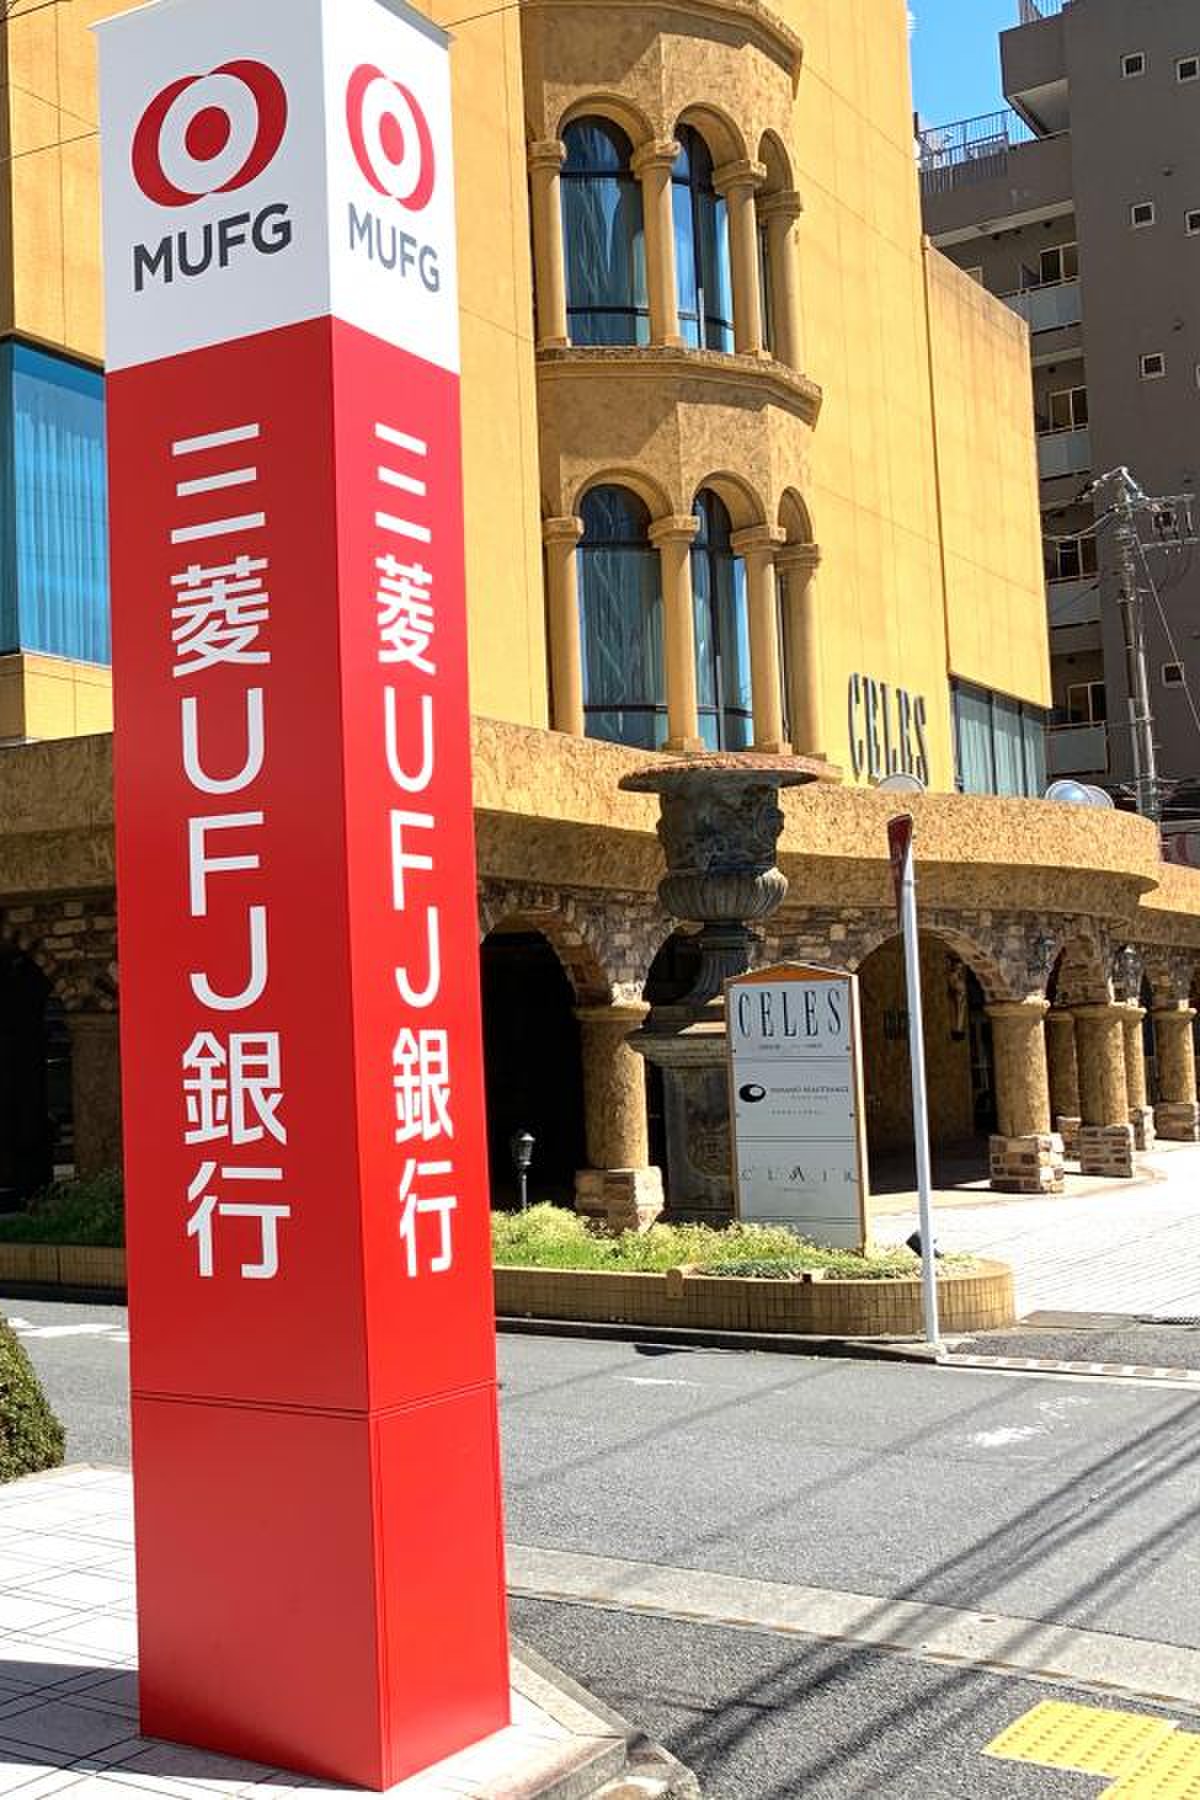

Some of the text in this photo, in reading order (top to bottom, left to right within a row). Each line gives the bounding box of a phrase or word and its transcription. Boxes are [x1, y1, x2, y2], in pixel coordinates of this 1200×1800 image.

[133, 203, 292, 292] MUFG
[348, 202, 440, 293] MUFG
[847, 673, 929, 787] CELES
[170, 423, 291, 1279] 三菱UFJ銀行
[375, 423, 458, 1278] 三菱UFJ銀行
[738, 987, 842, 1038] CELES
